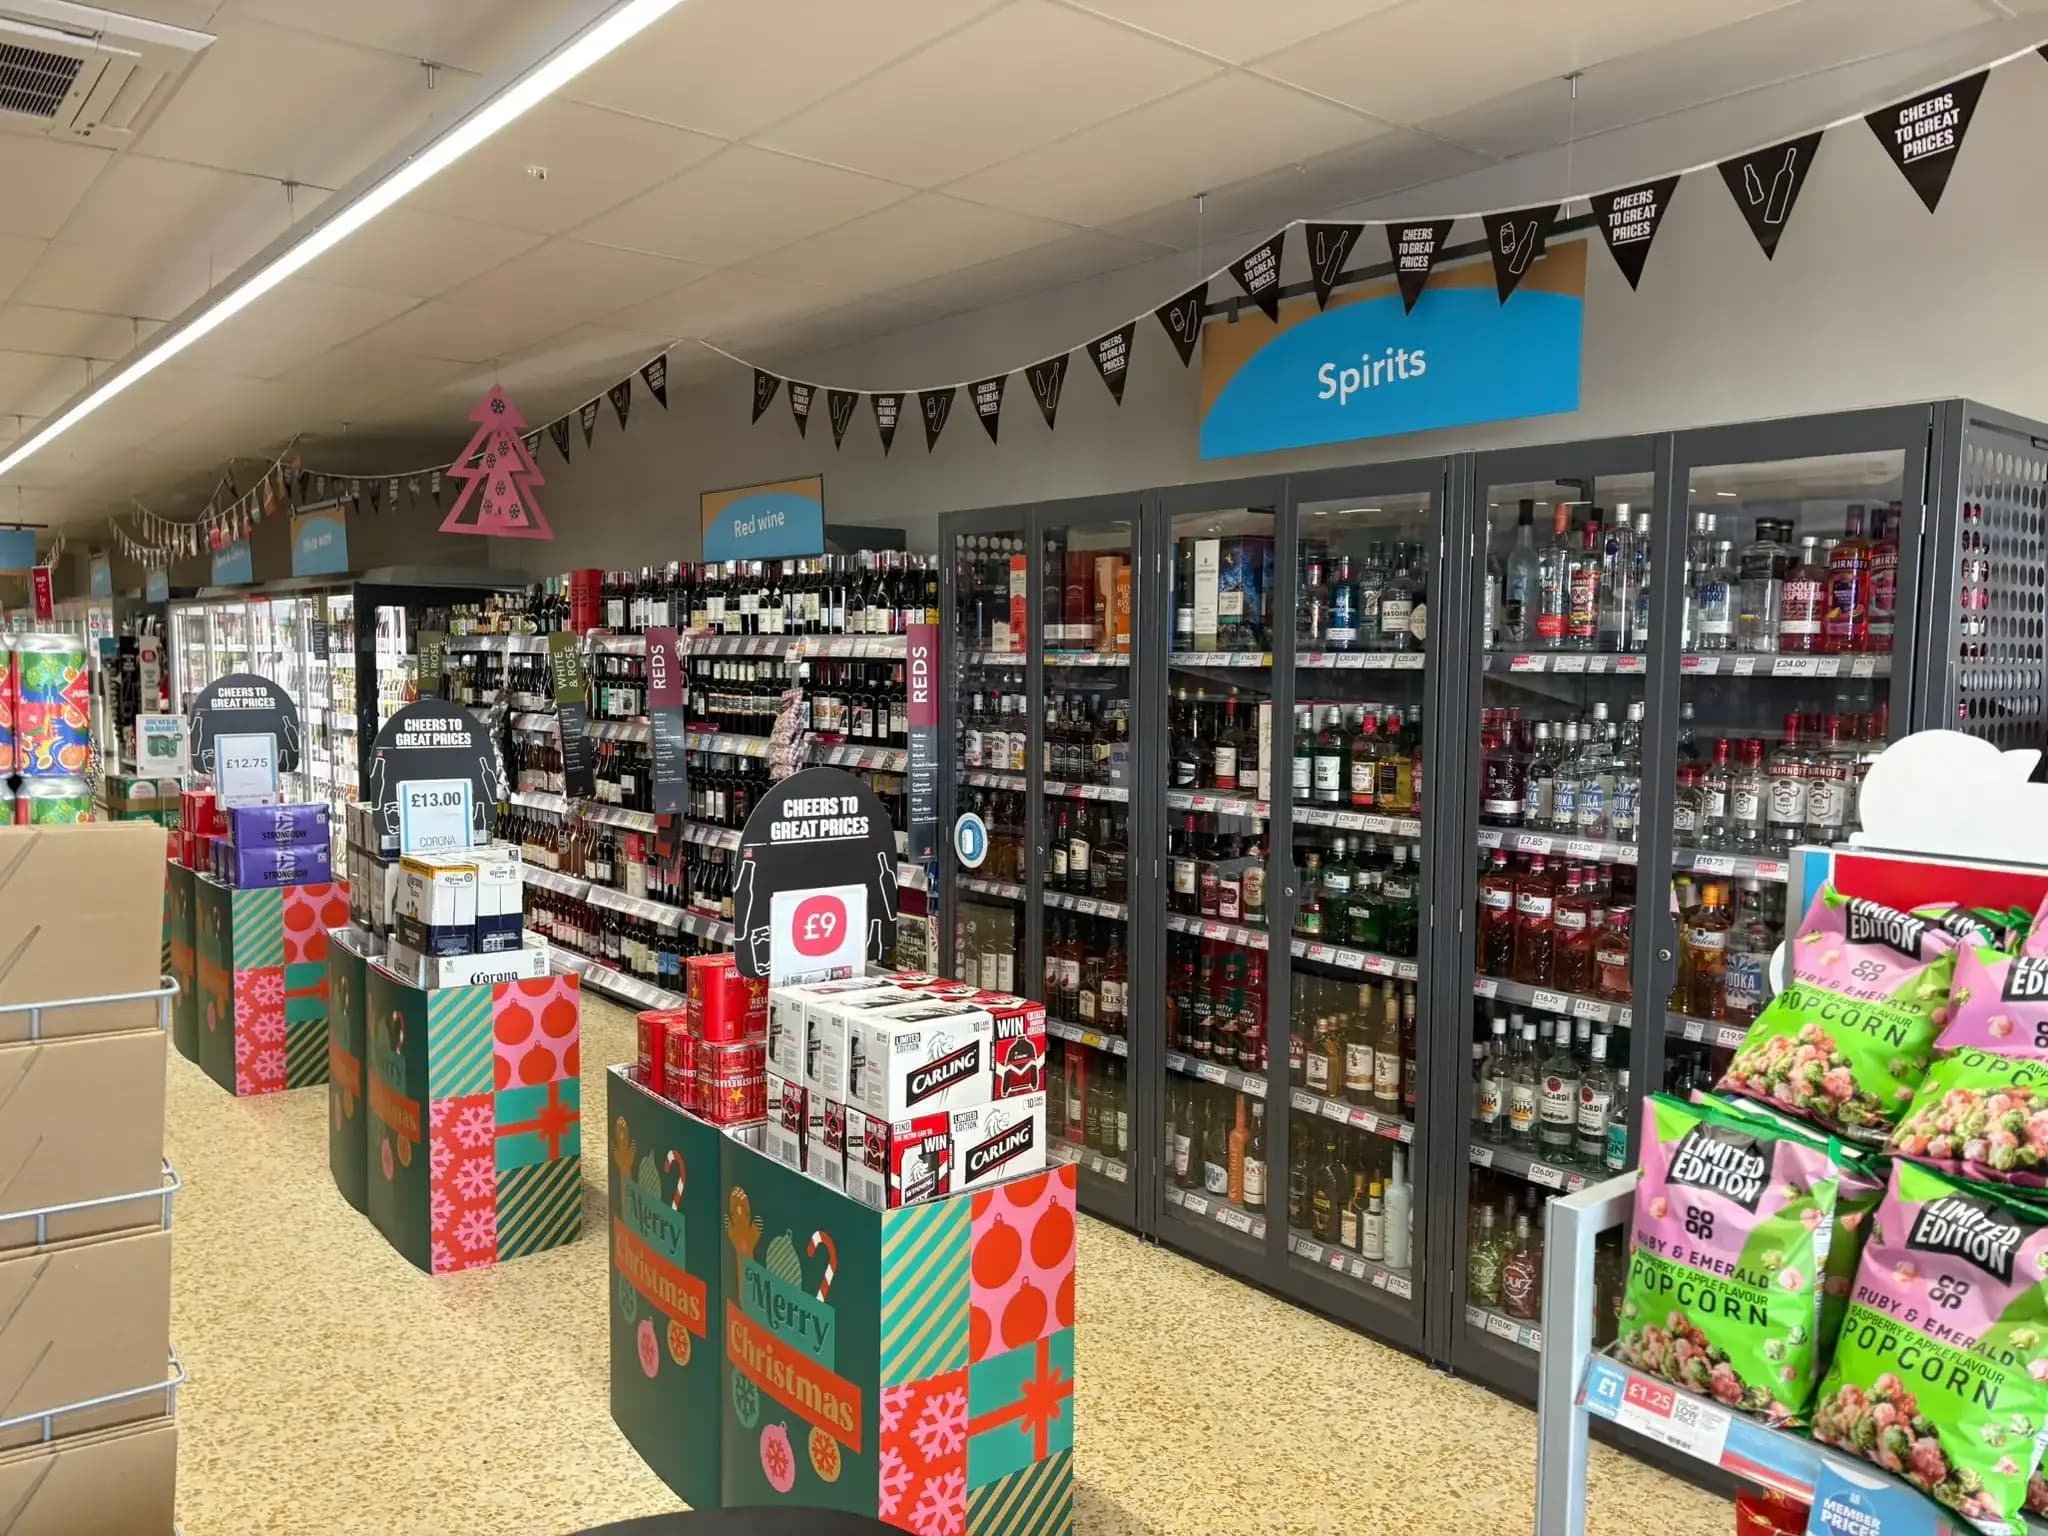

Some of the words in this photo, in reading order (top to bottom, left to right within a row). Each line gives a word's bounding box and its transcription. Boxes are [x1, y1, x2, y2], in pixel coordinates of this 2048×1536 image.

[1899, 92, 1954, 126] CHEERS
[1894, 125, 1913, 144] TO
[1915, 107, 1960, 137] GREAT
[1903, 128, 1954, 159] PRICES
[1613, 189, 1654, 211] CHEERS
[1608, 212, 1622, 227] TO
[1622, 204, 1657, 224] GREAT
[1402, 227, 1433, 241] CHEERS
[1613, 221, 1651, 242] PRICES
[1244, 246, 1272, 270] CHEERS
[1399, 243, 1409, 256] TO
[1408, 241, 1435, 255] GREAT
[1243, 268, 1254, 283] TO
[1253, 255, 1277, 276] GREAT
[1400, 255, 1429, 269] PRICES
[1249, 268, 1276, 293] PRICES
[1098, 352, 1107, 363] TO
[1107, 343, 1126, 358] GREAT
[1100, 333, 1123, 352] CHEERS
[1103, 355, 1125, 372] PRICES
[1318, 347, 1427, 406] Spirits
[734, 514, 755, 538] Red
[758, 510, 784, 531] wine
[554, 651, 567, 689] WHITE
[651, 644, 667, 689] REDS
[912, 646, 928, 703] REDS
[1776, 659, 1807, 669] £24.00
[218, 687, 254, 698] CHEERS
[254, 687, 267, 697] TO
[569, 678, 578, 688] &
[211, 698, 242, 708] GREAT
[242, 697, 276, 708] PRICES
[404, 719, 447, 732] CHEERS
[447, 718, 463, 731] TO
[395, 733, 432, 746] GREAT
[433, 732, 472, 746] PRICES
[225, 757, 268, 769] £12.75
[411, 792, 462, 808] £13.00
[783, 797, 839, 818] CHEERS
[840, 796, 859, 814] TO
[770, 819, 818, 841] GREAT
[819, 816, 869, 838] PRICES
[419, 836, 456, 848] CORONA
[1520, 835, 1543, 847] £7.85
[803, 911, 837, 941] £9
[1851, 915, 1915, 951] EDITION
[470, 971, 518, 985] Corona
[1844, 984, 1921, 1015] EMERALD
[973, 1022, 980, 1032] 10
[997, 1016, 1024, 1039] WIN
[1779, 991, 1908, 1048] POPCORN
[895, 1033, 920, 1043] LIMITED
[896, 1044, 919, 1054] EDITION
[911, 1053, 975, 1095] CARLING
[1027, 1098, 1034, 1108] 10
[895, 1122, 910, 1133] FIND
[954, 1111, 978, 1122] LIMITED
[956, 1121, 977, 1132] EDITION
[924, 1135, 947, 1153] WIN
[970, 1127, 1030, 1171] CARLING
[1684, 1132, 1766, 1178] LIMITED
[1531, 1166, 1554, 1178] £26.00
[1672, 1152, 1762, 1203] EDITION
[906, 1179, 934, 1198] WINNING
[628, 1182, 681, 1255] Merry
[1928, 1197, 2021, 1246] LIMITED
[1914, 1214, 2010, 1274] EDITION
[618, 1233, 700, 1322] Christmas
[1672, 1245, 1683, 1259] &
[1690, 1251, 1769, 1289] EMERALD
[1632, 1259, 1768, 1327] POPCORN
[1677, 1266, 1684, 1278] &
[1686, 1270, 1718, 1290] APPLE
[1719, 1282, 1769, 1306] FLAVOUR
[745, 1268, 829, 1356] Merry
[1857, 1286, 1902, 1313] RUBY
[1904, 1308, 1918, 1322] &
[1923, 1318, 2016, 1367] EMERALD
[1851, 1305, 1904, 1338] RASPBERRY
[1905, 1331, 1913, 1342] &
[1916, 1336, 1950, 1360] APPLE
[1950, 1347, 2005, 1384] FLAVOUR
[1843, 1318, 1999, 1410] POPCORN
[731, 1319, 854, 1433] Christmas
[1598, 1377, 1617, 1398] £1
[1628, 1383, 1670, 1410] £1.25
[1674, 1413, 1696, 1428] PRICE
[1676, 1405, 1698, 1419] LOW
[1820, 1509, 1881, 1536] PRICES
[1823, 1498, 1881, 1529] MEMBER
